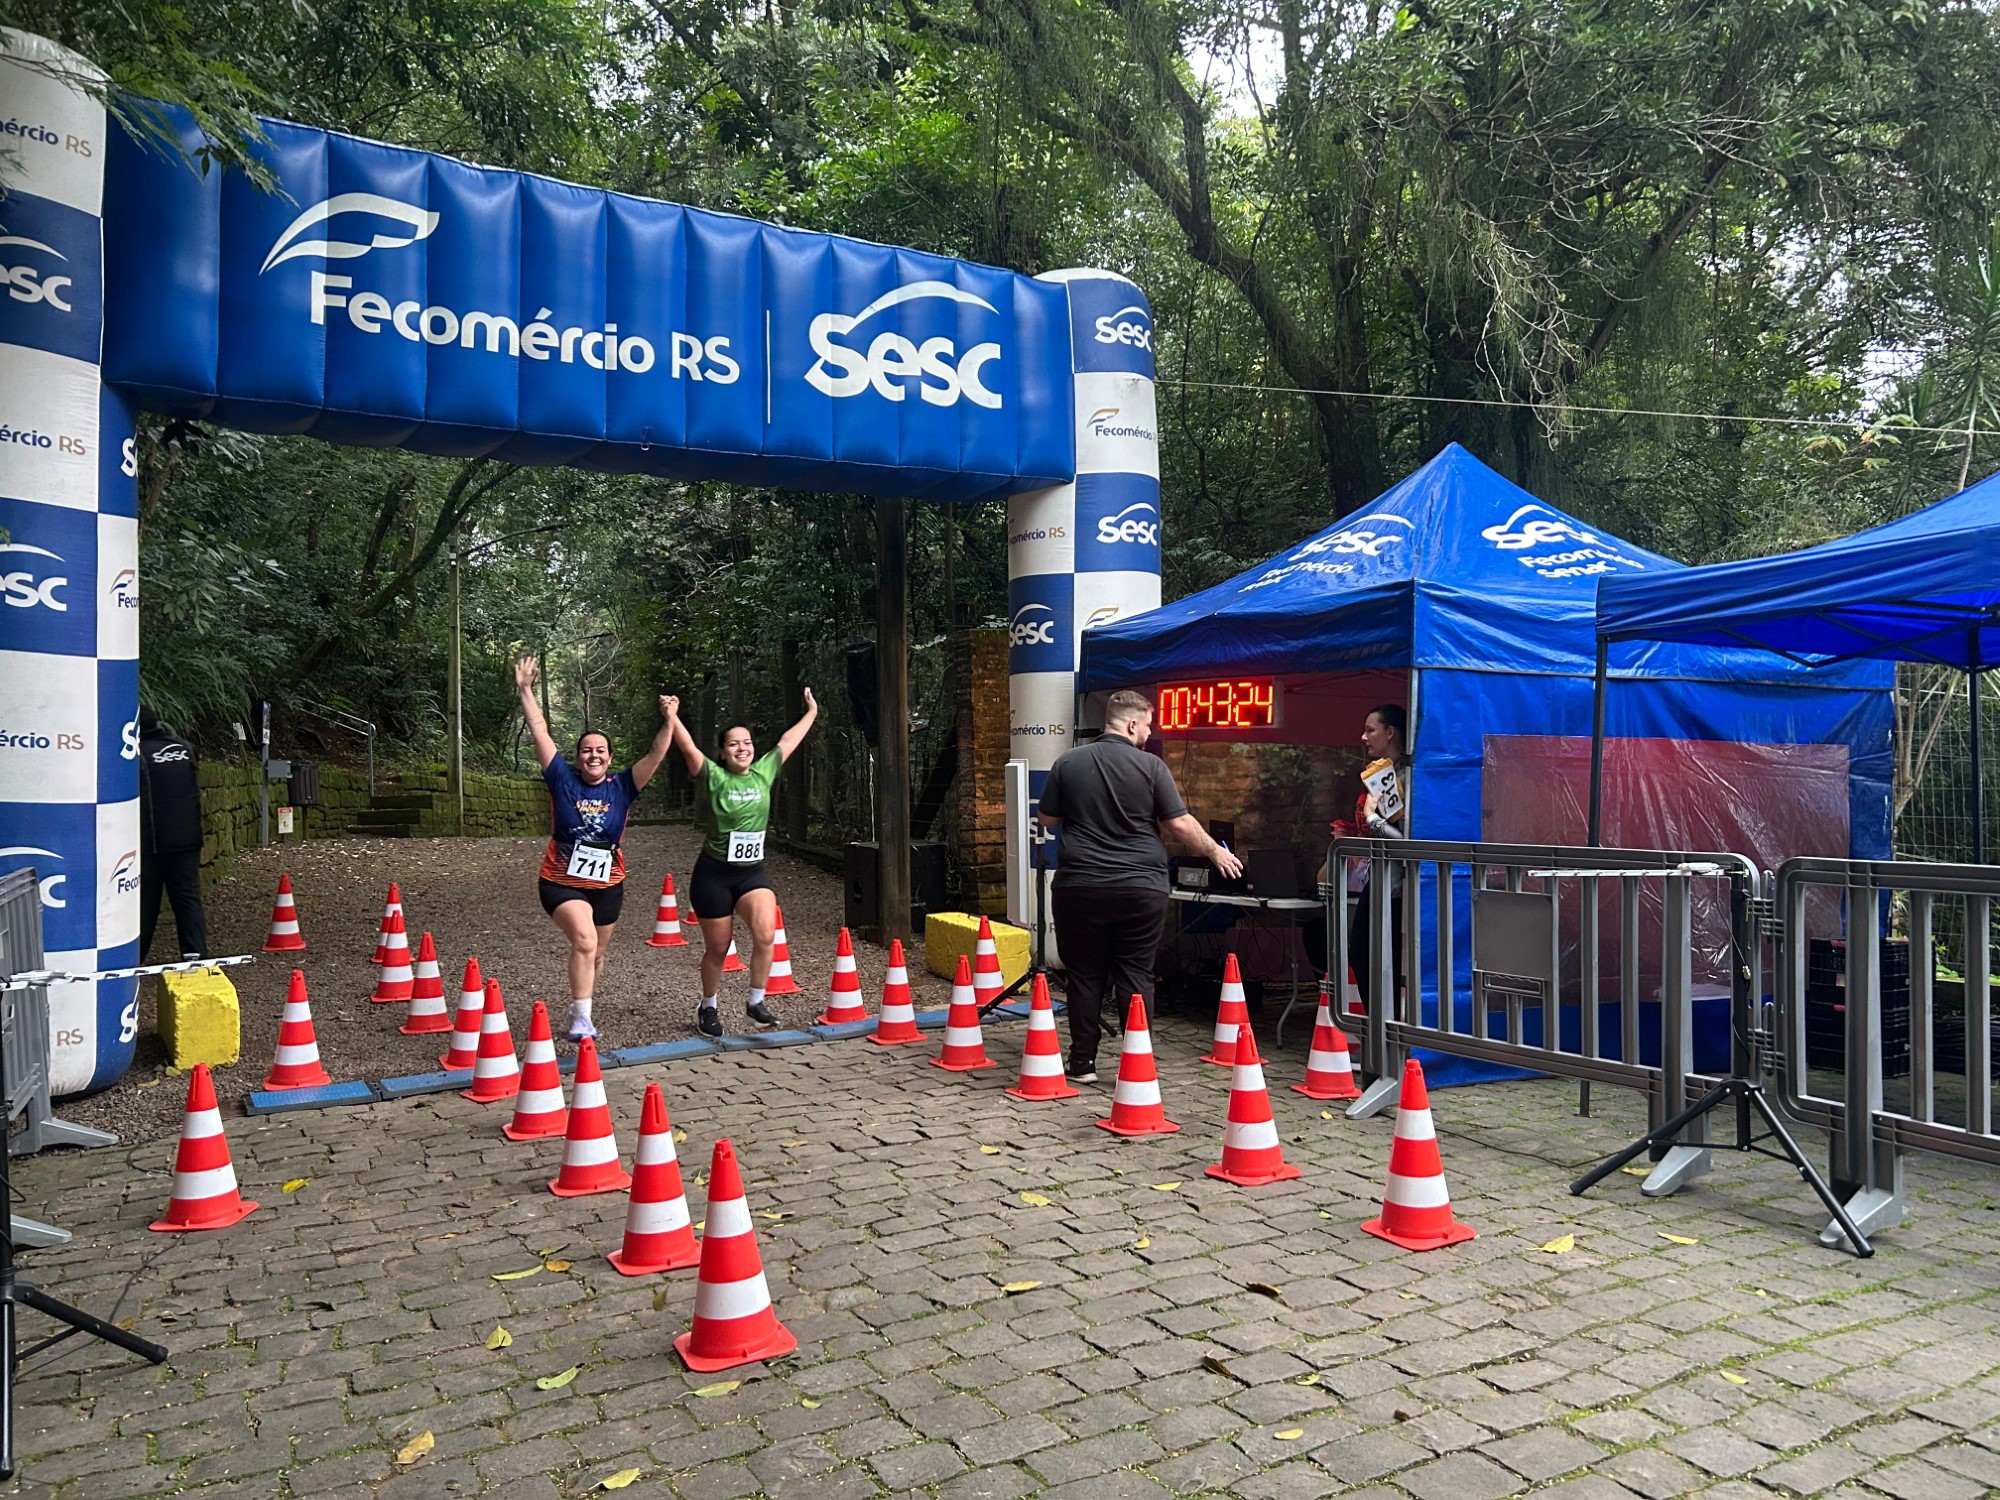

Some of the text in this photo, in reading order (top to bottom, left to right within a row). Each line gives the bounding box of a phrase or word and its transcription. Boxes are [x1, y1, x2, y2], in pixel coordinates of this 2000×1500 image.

[65, 134, 92, 158] RS
[310, 270, 741, 385] Fecomércio RS
[804, 298, 1003, 409] Sesc
[58, 435, 86, 456] RS
[1048, 527, 1066, 539] RS
[1095, 510, 1158, 546] Sesc
[1160, 682, 1274, 730] 00:43:24
[1048, 724, 1066, 736] RS
[57, 733, 84, 751] RS
[152, 747, 190, 763] Sesc
[734, 842, 760, 859] 888
[576, 857, 607, 879] 711
[56, 1028, 84, 1047] RS
